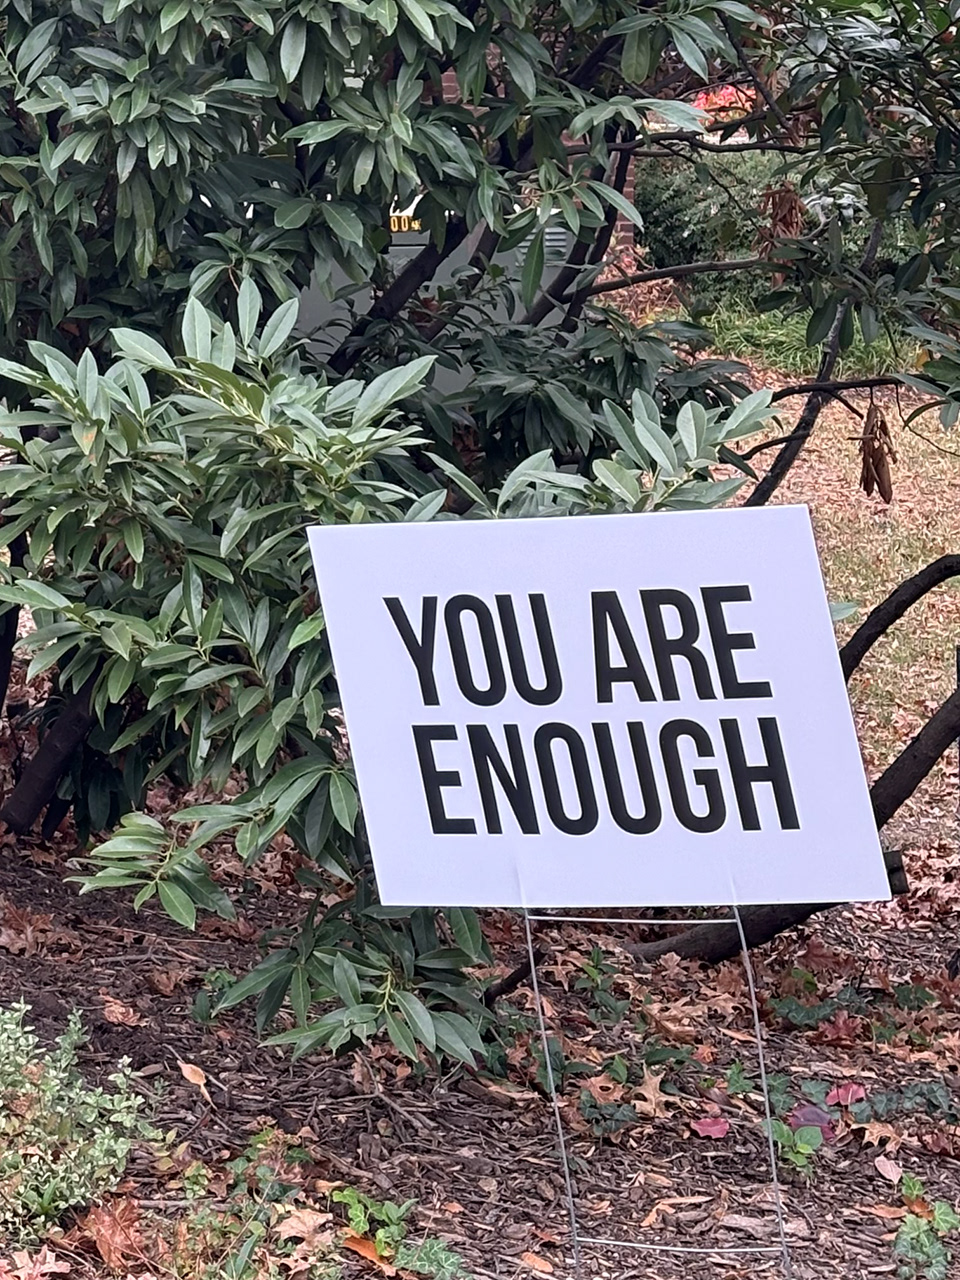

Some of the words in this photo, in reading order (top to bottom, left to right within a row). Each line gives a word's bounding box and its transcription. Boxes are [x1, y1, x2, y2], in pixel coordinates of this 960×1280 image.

[382, 593, 563, 707] YOU
[591, 584, 773, 704] ARE
[411, 717, 801, 836] ENOUGH
